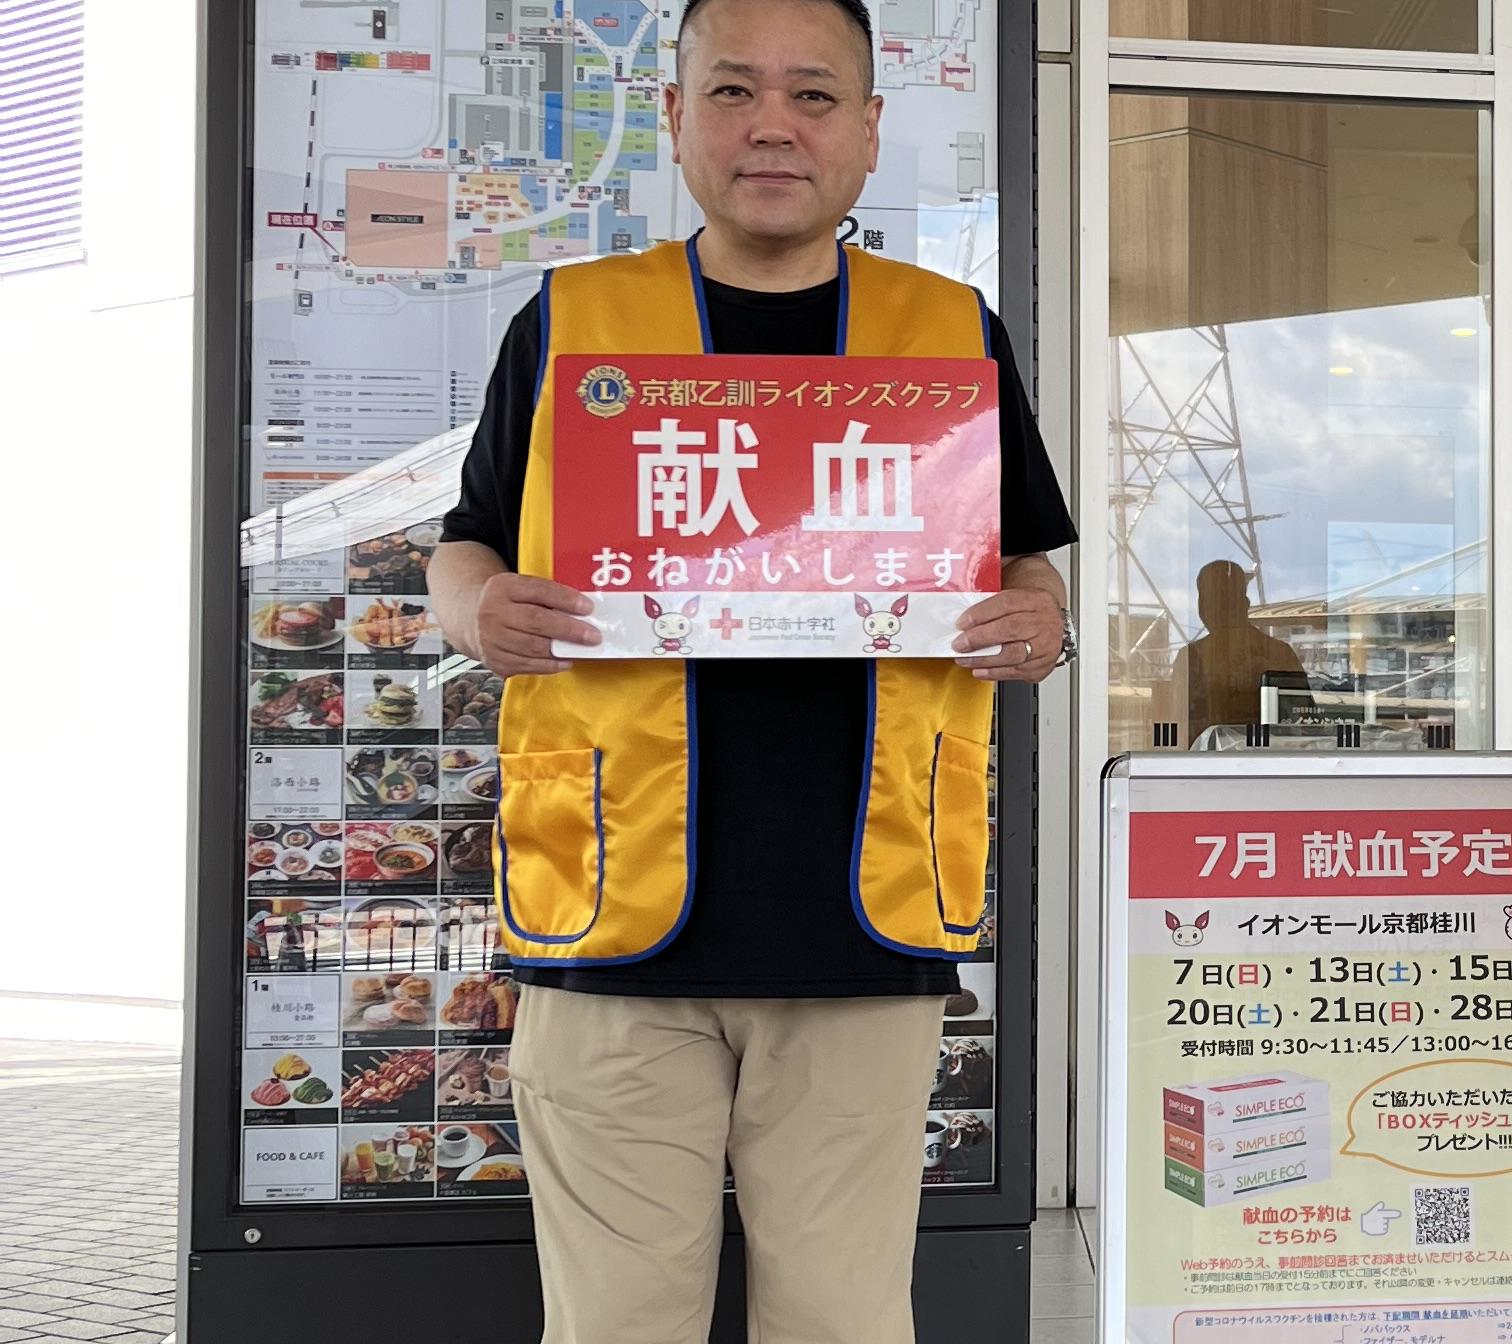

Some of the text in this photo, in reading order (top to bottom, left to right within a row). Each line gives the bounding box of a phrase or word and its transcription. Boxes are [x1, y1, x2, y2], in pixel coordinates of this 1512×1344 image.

[639, 378, 984, 410] 京都乙訓ライオンズクラブ
[632, 417, 925, 538] 献血
[590, 546, 966, 588] おねがいします
[748, 616, 836, 632] 日本赤十字社
[1194, 832, 1276, 879] 7月
[1237, 911, 1476, 937] イオンモール京都桂川
[1180, 1040, 1254, 1058] 受付時間
[1236, 1098, 1277, 1118] SIMPLE
[1236, 1133, 1277, 1154] SIMPLE
[256, 1151, 325, 1163] FOOD & CAFE
[1236, 1168, 1277, 1189] SIMPLE
[1242, 1205, 1353, 1225] 献血の予約は
[1257, 1228, 1338, 1245] こちらから
